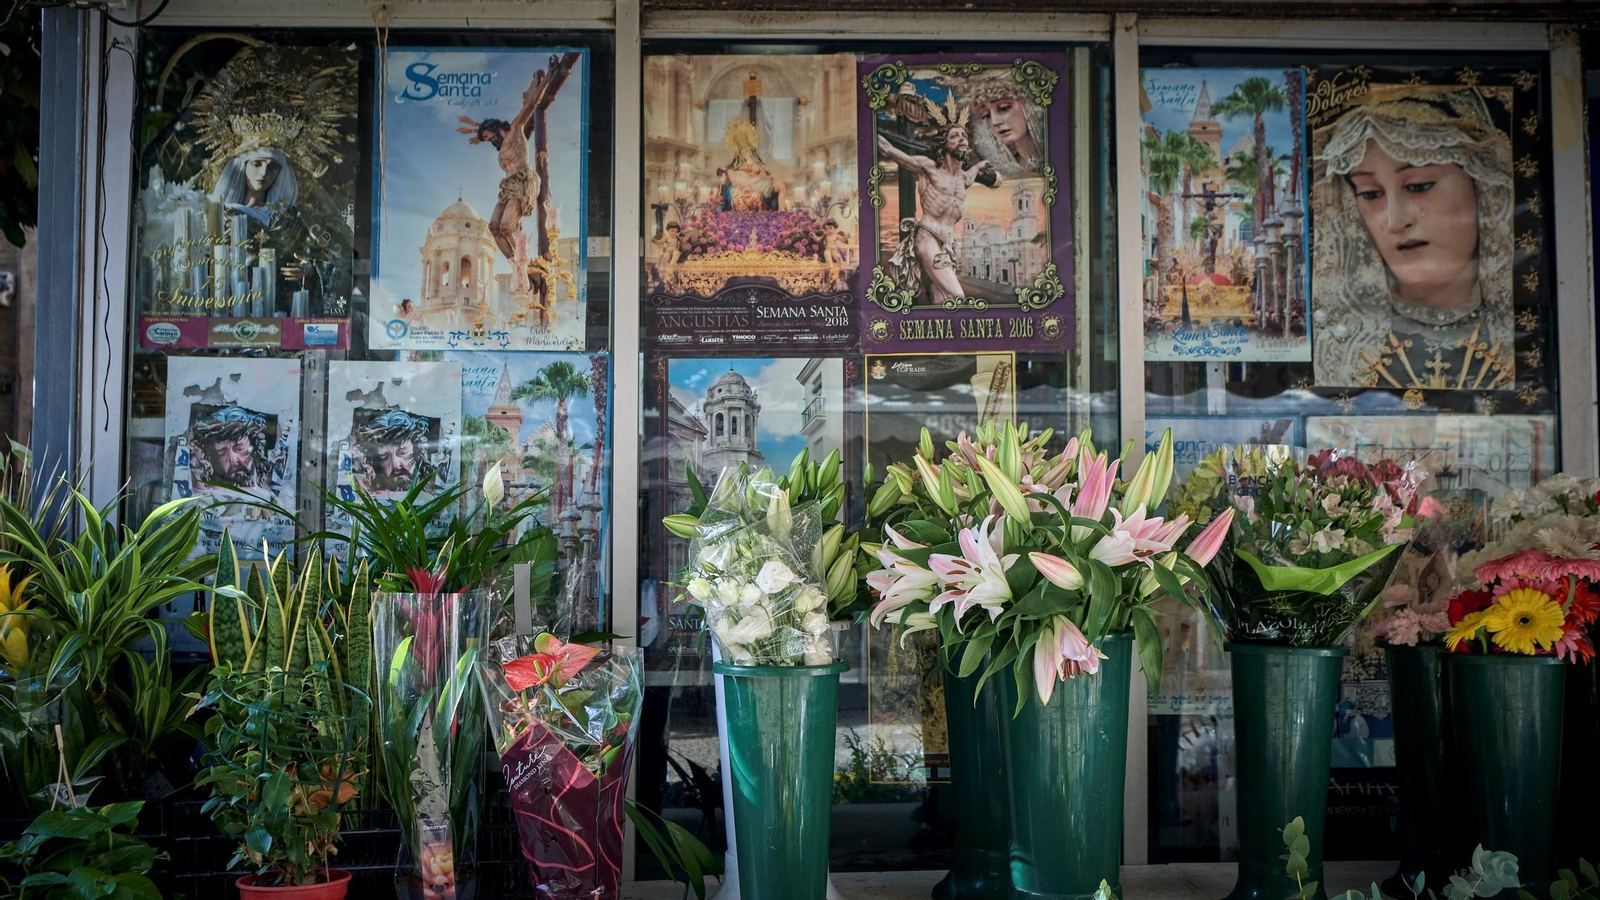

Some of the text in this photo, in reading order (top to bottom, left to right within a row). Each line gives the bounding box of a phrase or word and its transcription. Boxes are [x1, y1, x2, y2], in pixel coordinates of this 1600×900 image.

[1143, 78, 1197, 95] Semana
[1155, 91, 1197, 107] Santa
[1306, 81, 1367, 118] Dolores
[157, 281, 262, 309] Aniversario
[757, 305, 806, 318] SEMANA
[810, 305, 848, 318] SANTA
[657, 314, 749, 328] ANGUSTIAS
[825, 317, 849, 327] 2018
[899, 318, 954, 340] SEMANA
[960, 318, 1003, 339] SANTA
[1009, 317, 1034, 338] 2016
[1165, 323, 1248, 345] Lunes Santo
[462, 366, 498, 375] mana
[1473, 452, 1531, 474] 2023
[669, 616, 703, 630] SANT
[513, 753, 553, 790] DIAMOND LINE
